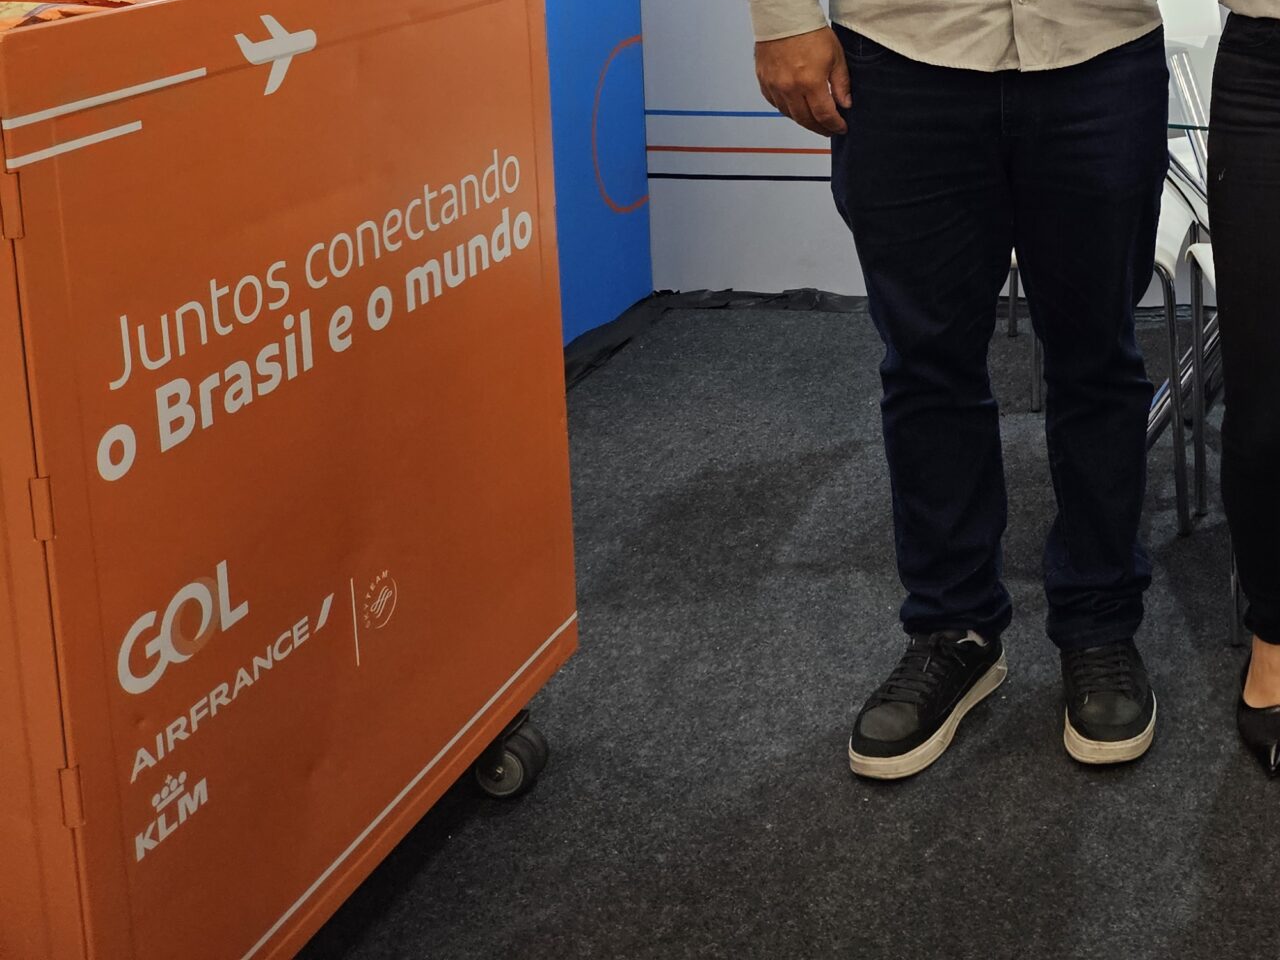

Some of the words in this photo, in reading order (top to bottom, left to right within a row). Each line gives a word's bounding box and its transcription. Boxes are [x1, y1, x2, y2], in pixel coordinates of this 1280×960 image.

[96, 423, 137, 482] o
[154, 309, 314, 453] Brasil
[328, 305, 354, 353] e
[367, 285, 394, 331] o
[405, 207, 533, 313] mundo
[109, 260, 290, 391] Juntos
[304, 149, 521, 289] conectando
[117, 559, 250, 695] GOL
[130, 616, 310, 784] AIRFRANCE
[135, 776, 209, 863] KLM
